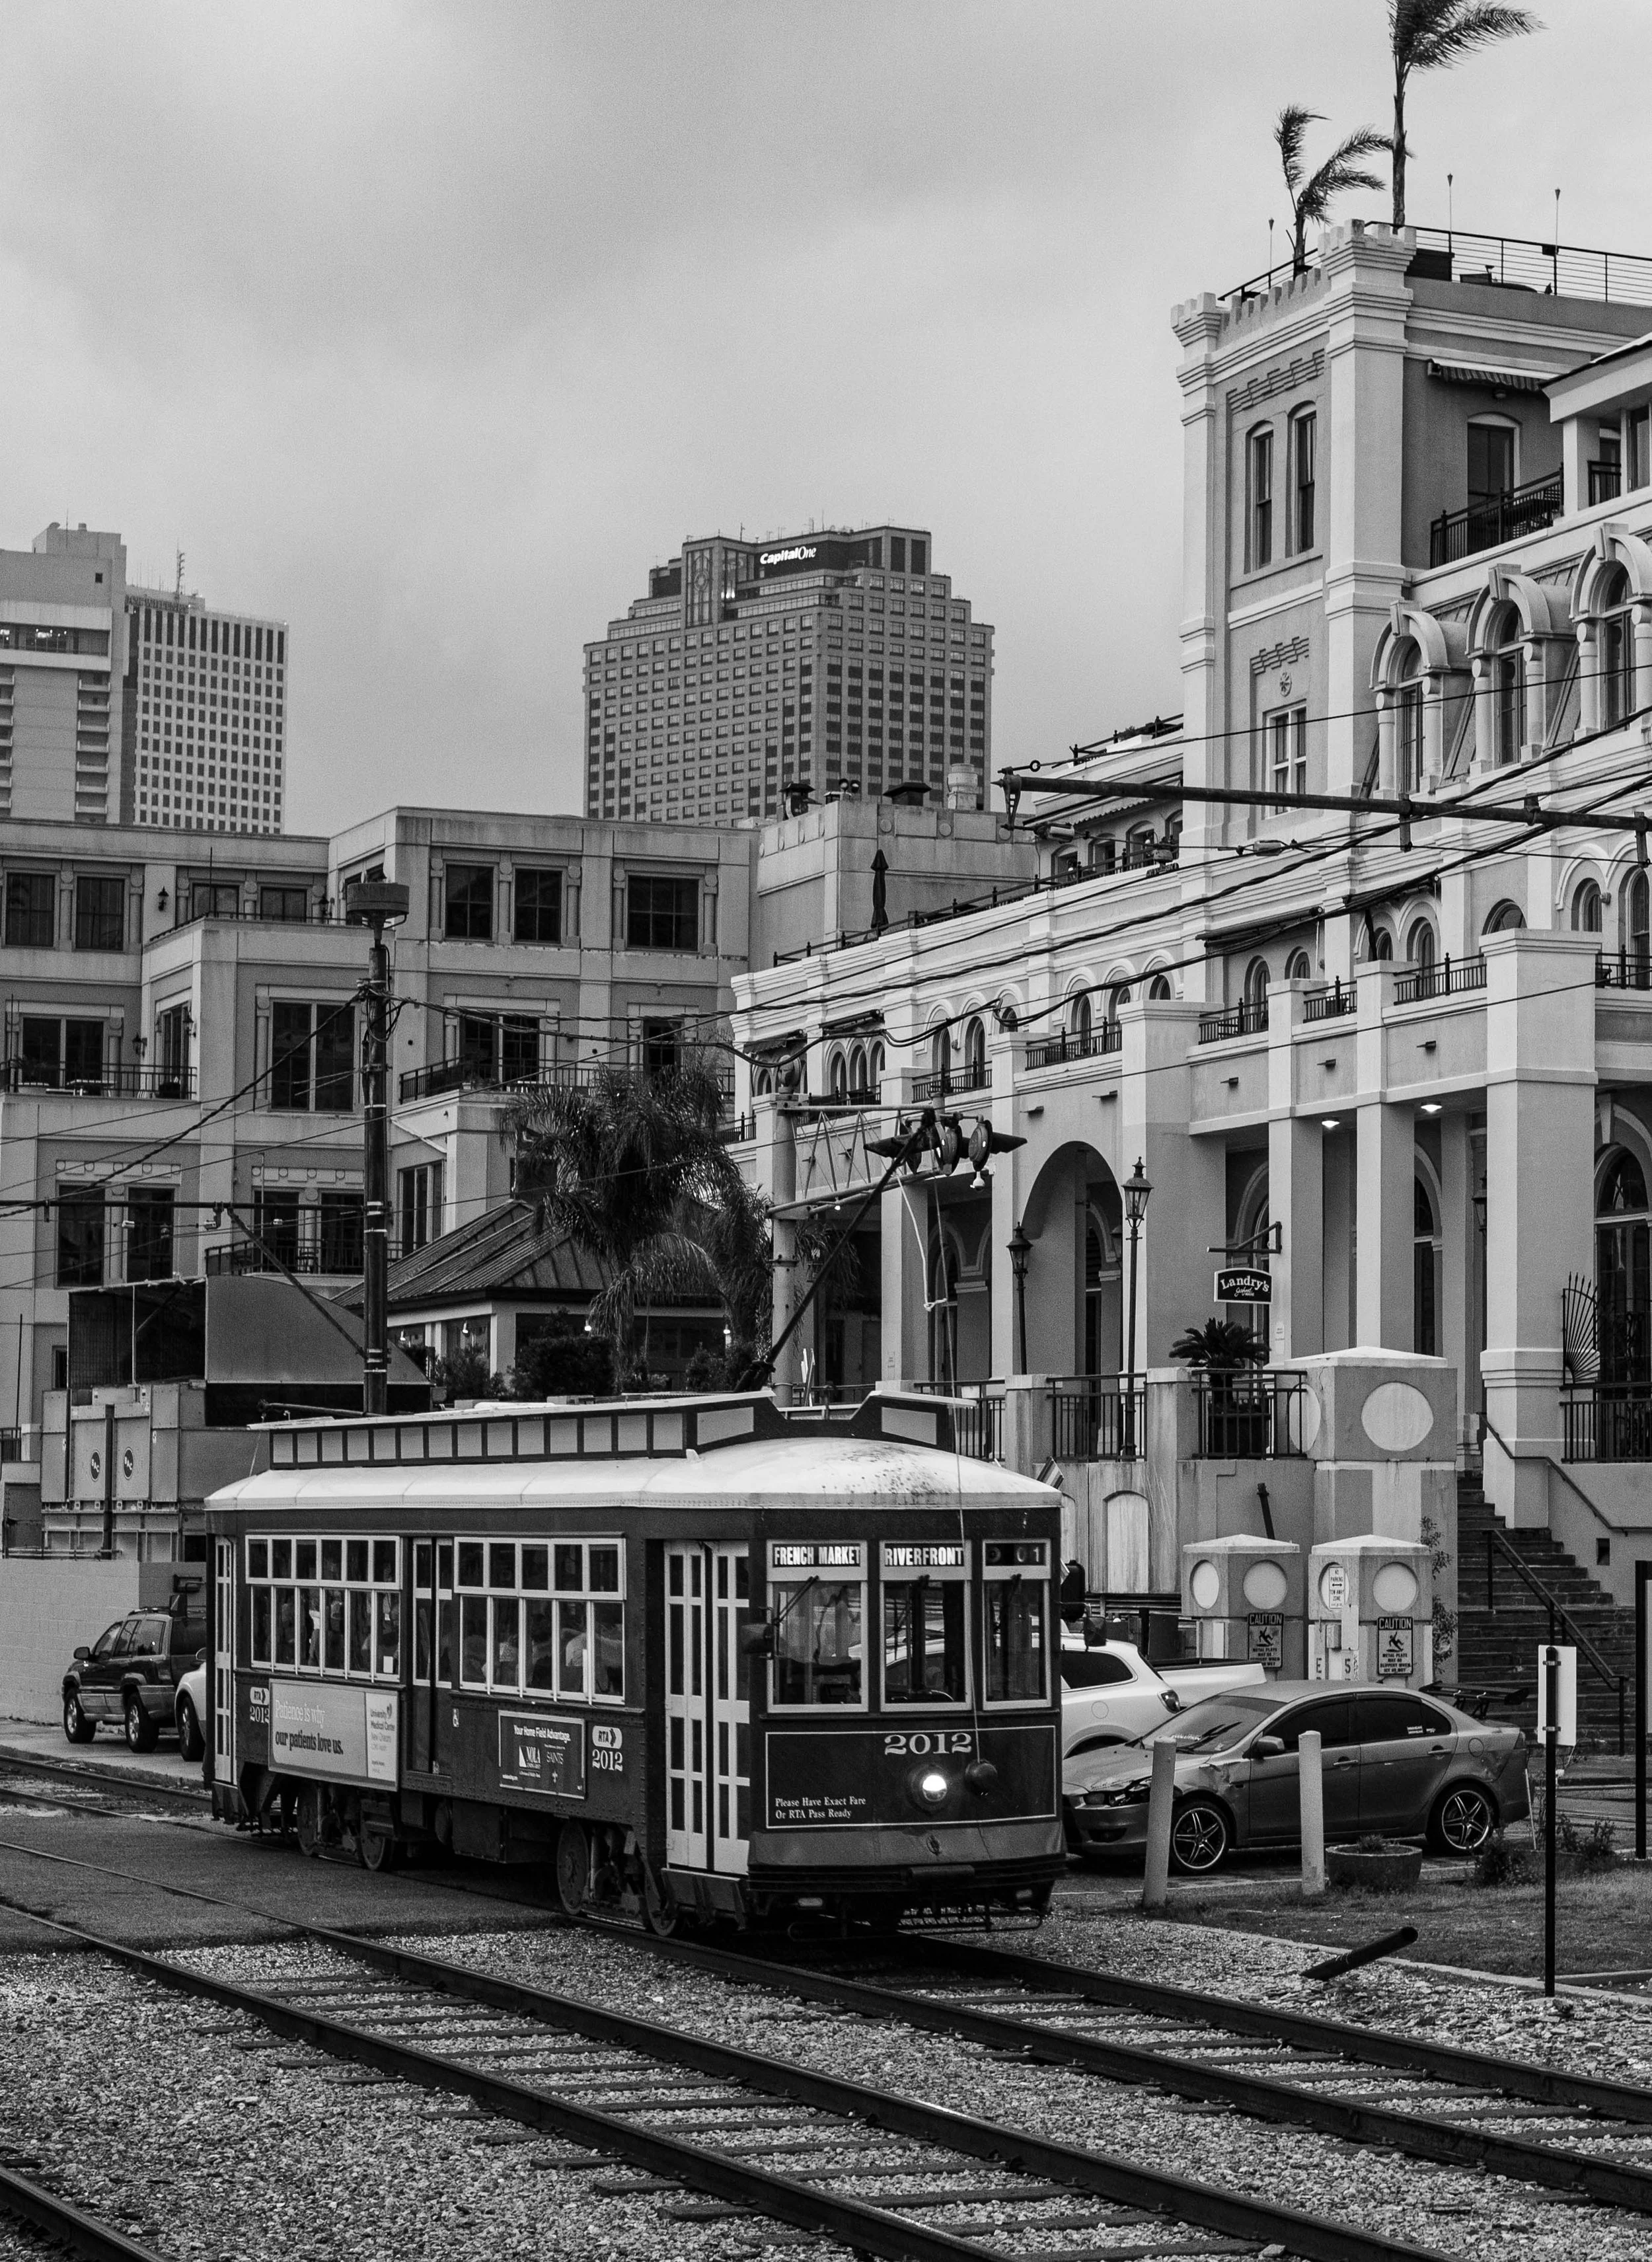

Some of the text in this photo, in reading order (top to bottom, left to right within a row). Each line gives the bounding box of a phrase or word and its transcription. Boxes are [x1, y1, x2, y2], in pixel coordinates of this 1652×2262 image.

[1220, 1275, 1269, 1293] Landry's
[774, 1546, 860, 1565] FRENCH MARKET
[885, 1547, 964, 1566] RIVERFRONT
[1250, 1614, 1282, 1625] CAUTION
[1379, 1618, 1411, 1630] CAUTION
[250, 1706, 270, 1723] 2012
[276, 1699, 326, 1729] Patience is why
[513, 1724, 523, 1736] Your
[523, 1725, 536, 1737] Home
[535, 1727, 546, 1739] Field
[598, 1730, 609, 1743] RTA
[275, 1729, 344, 1755] our patients love us.
[884, 1733, 972, 1755] 2012
[592, 1749, 623, 1772] 2012
[775, 1795, 867, 1807] Please Have Exact Fare
[775, 1808, 852, 1819] Or RTA Pass Ready
